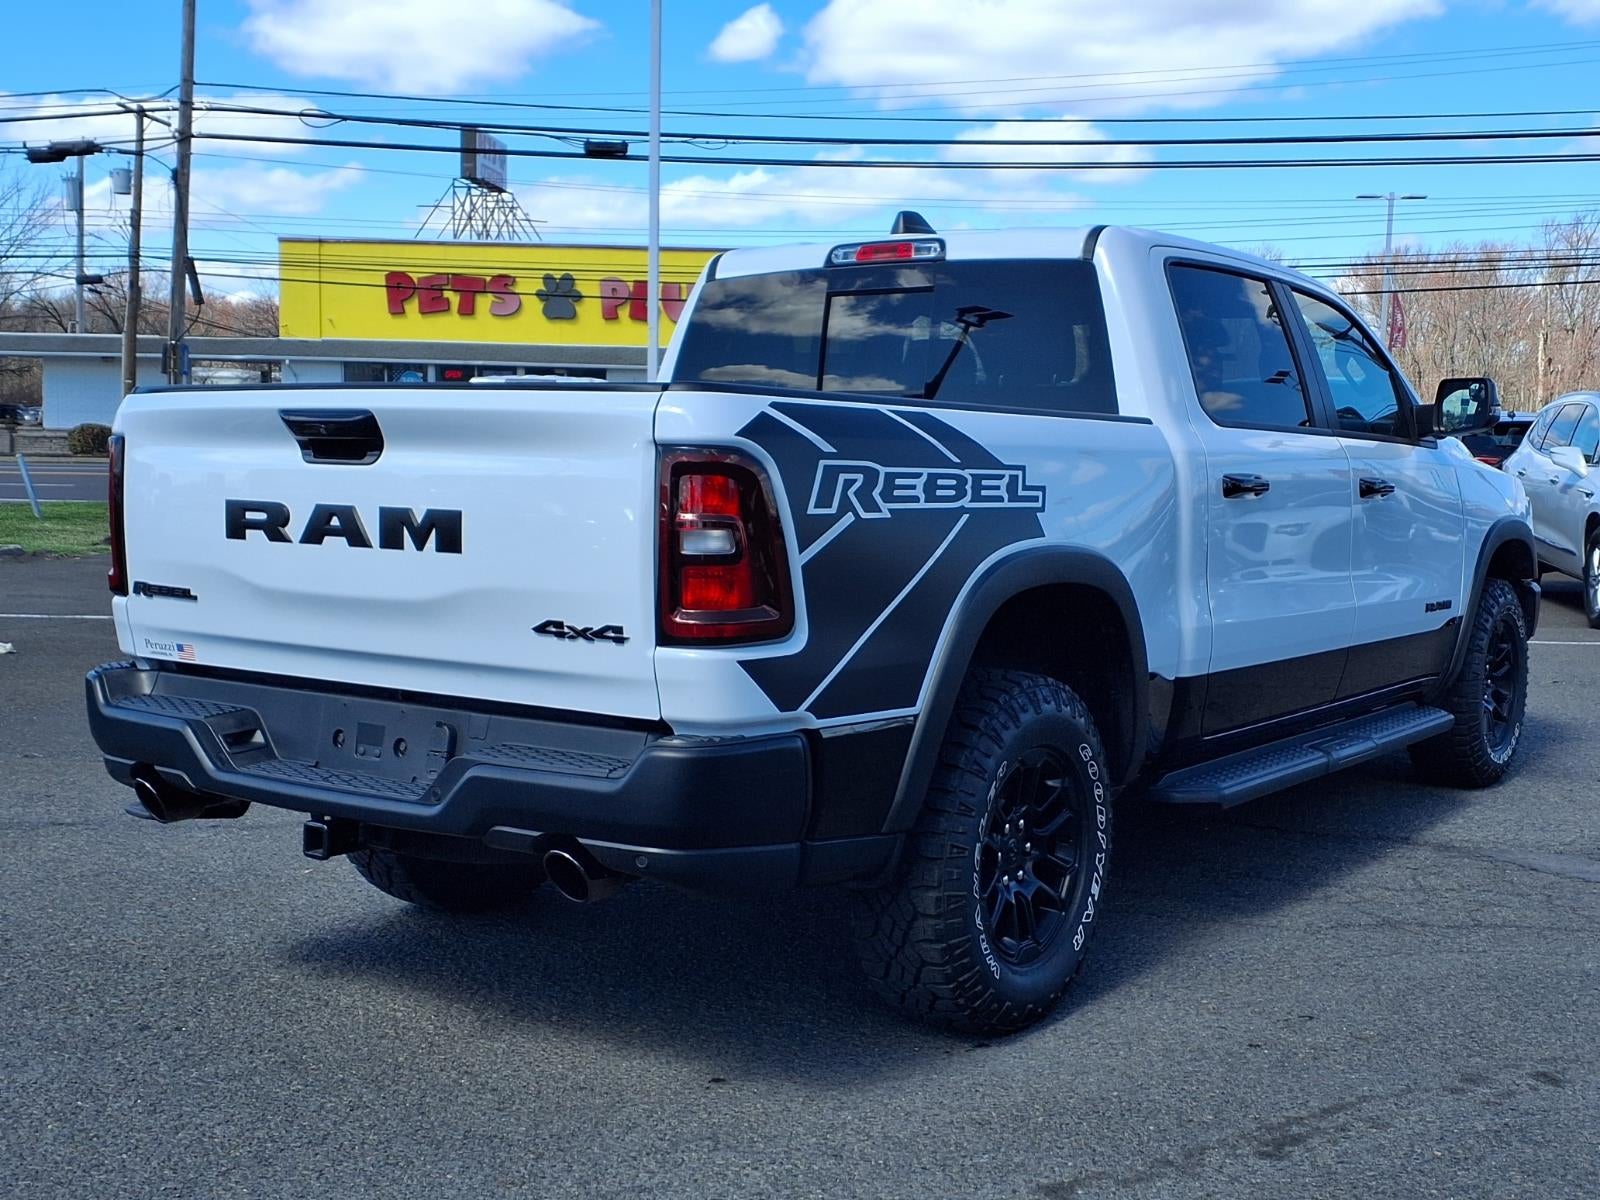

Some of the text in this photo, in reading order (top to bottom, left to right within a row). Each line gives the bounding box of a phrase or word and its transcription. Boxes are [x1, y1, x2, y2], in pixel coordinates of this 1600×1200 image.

[385, 271, 521, 316] PETS
[807, 460, 1045, 518] REBEL
[225, 499, 462, 554] RAM
[132, 580, 198, 600] REBEL
[144, 638, 175, 652] Peruzzi
[1073, 743, 1106, 950] GOODYEAR
